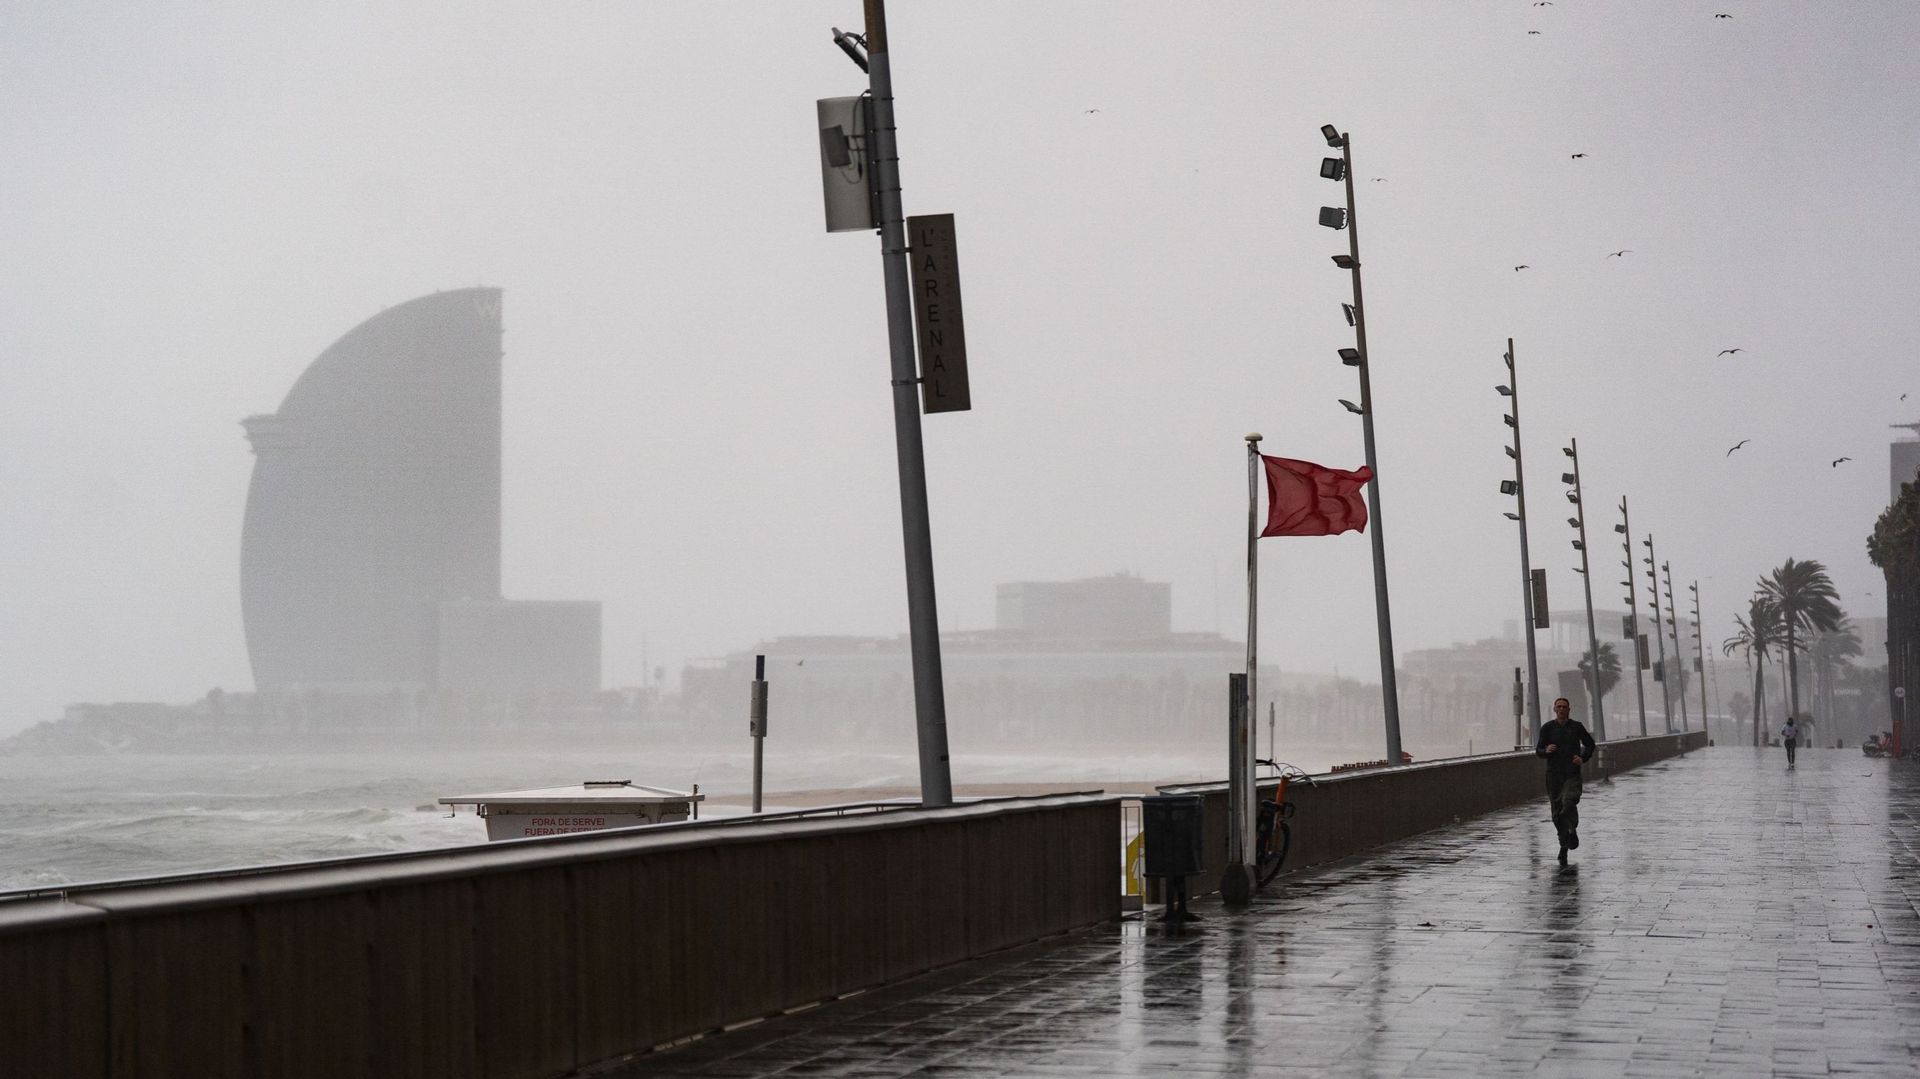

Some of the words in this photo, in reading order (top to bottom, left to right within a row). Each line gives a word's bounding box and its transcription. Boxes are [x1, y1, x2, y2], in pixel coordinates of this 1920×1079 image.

[921, 228, 947, 398] L'ARENAL
[532, 817, 556, 826] FORA
[558, 817, 570, 826] DE
[572, 817, 605, 826] SERVEI
[524, 827, 555, 836] FUERA
[557, 827, 569, 835] DE
